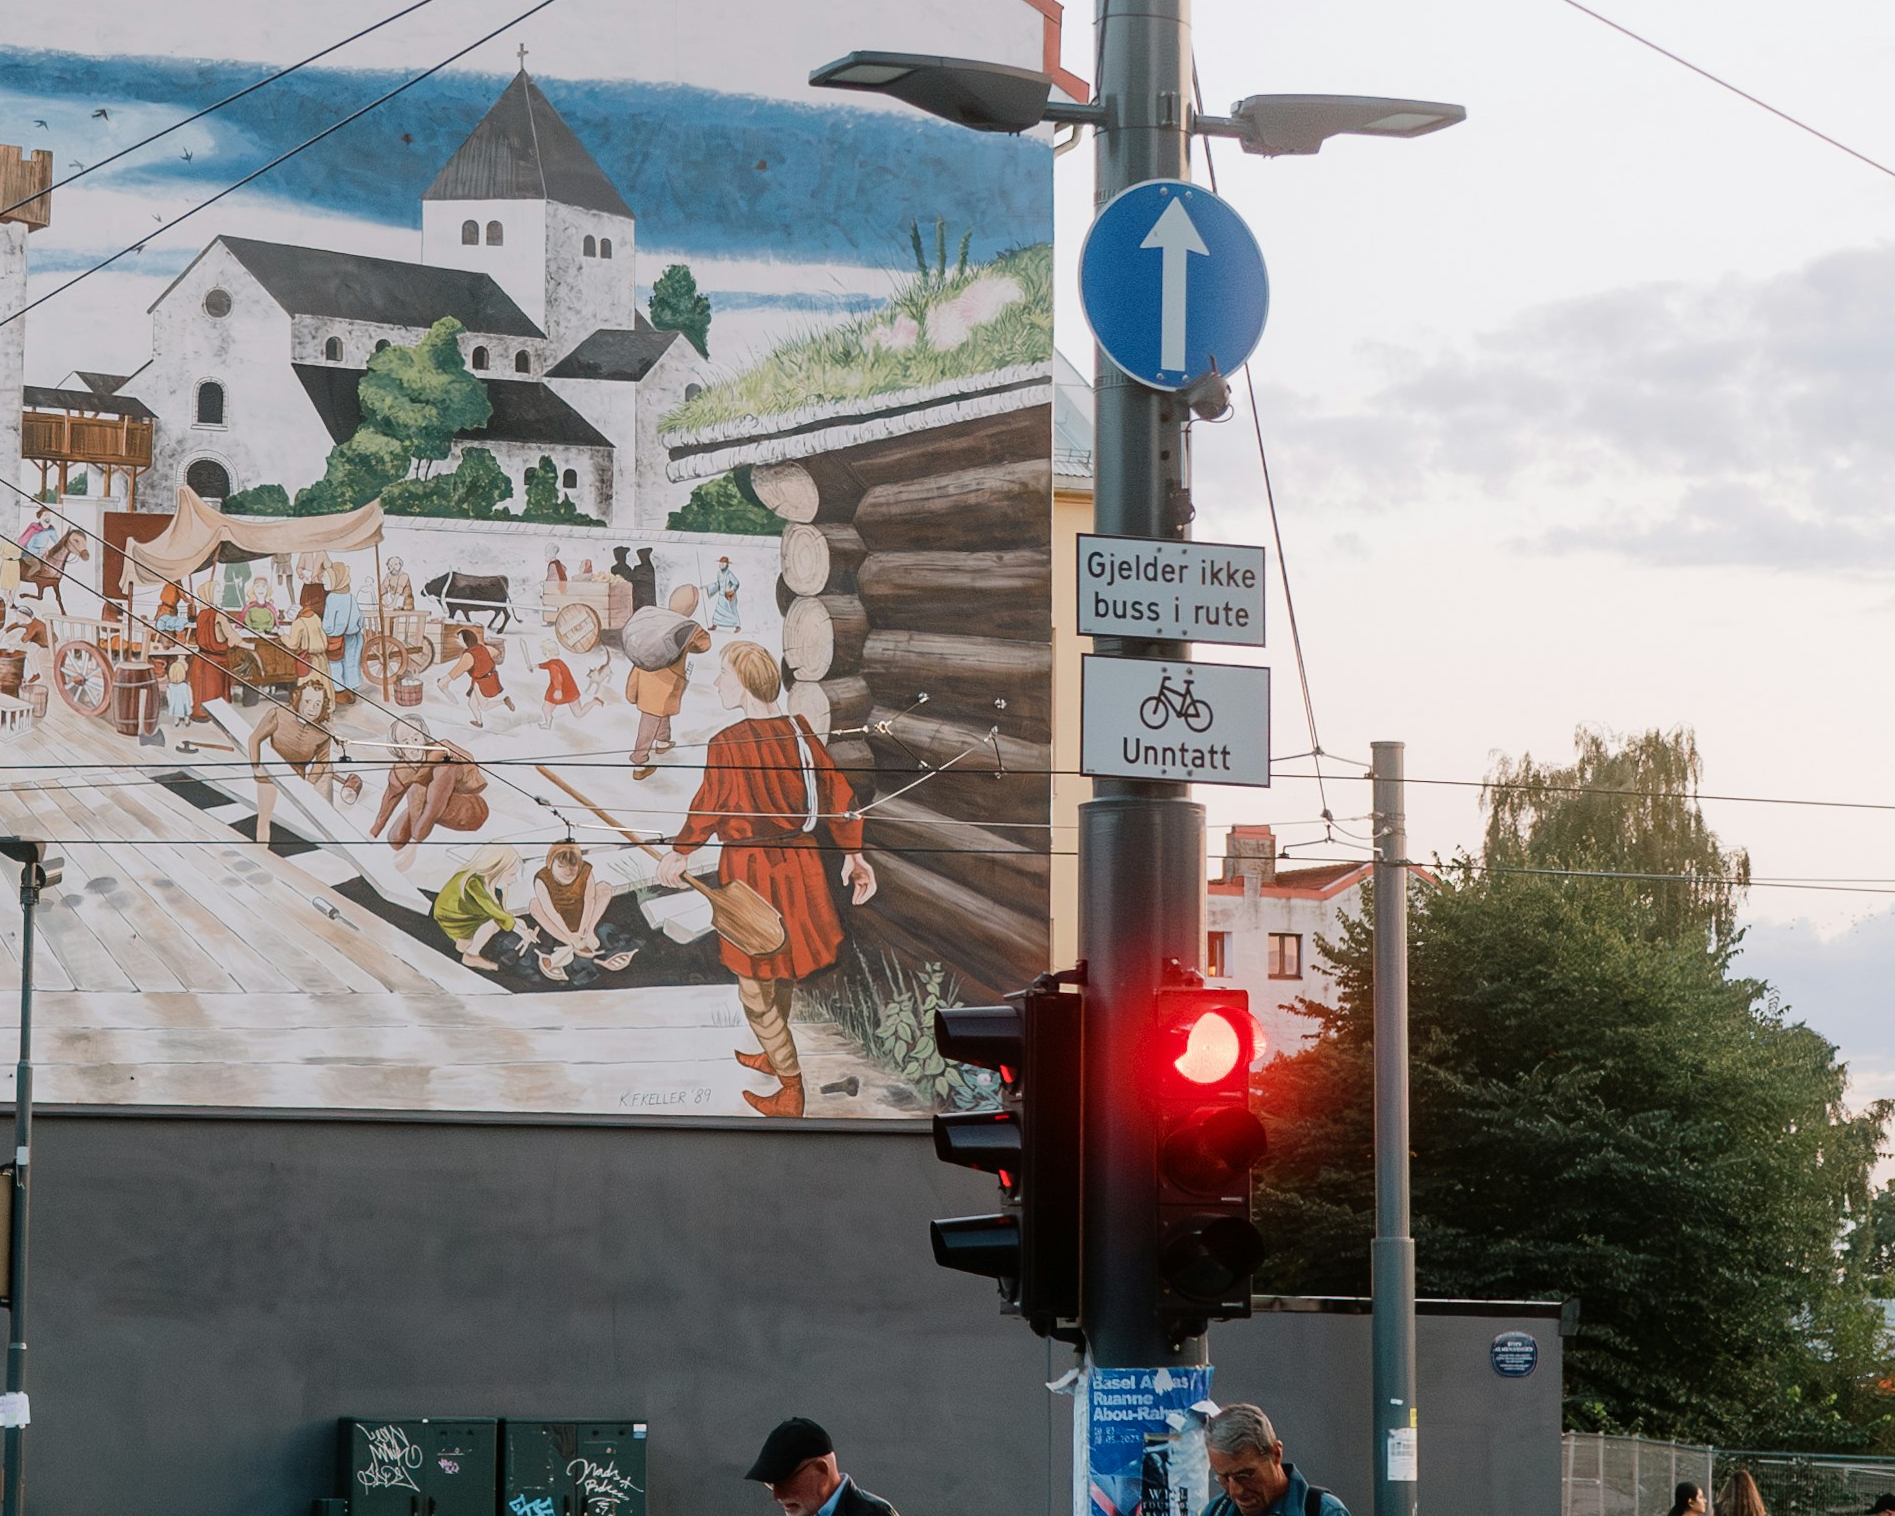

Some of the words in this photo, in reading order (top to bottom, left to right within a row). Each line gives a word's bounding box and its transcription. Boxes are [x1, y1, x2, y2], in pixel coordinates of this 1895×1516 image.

[1087, 551, 1188, 586] Gjelder
[1201, 559, 1255, 588] ikke
[1094, 591, 1160, 621] buss
[1174, 596, 1180, 623] i
[1194, 601, 1249, 627] rute
[1123, 737, 1231, 770] Unntatt
[1093, 1375, 1136, 1389] Basel
[1140, 1375, 1189, 1389] Aas
[1093, 1391, 1154, 1405] Ruanne
